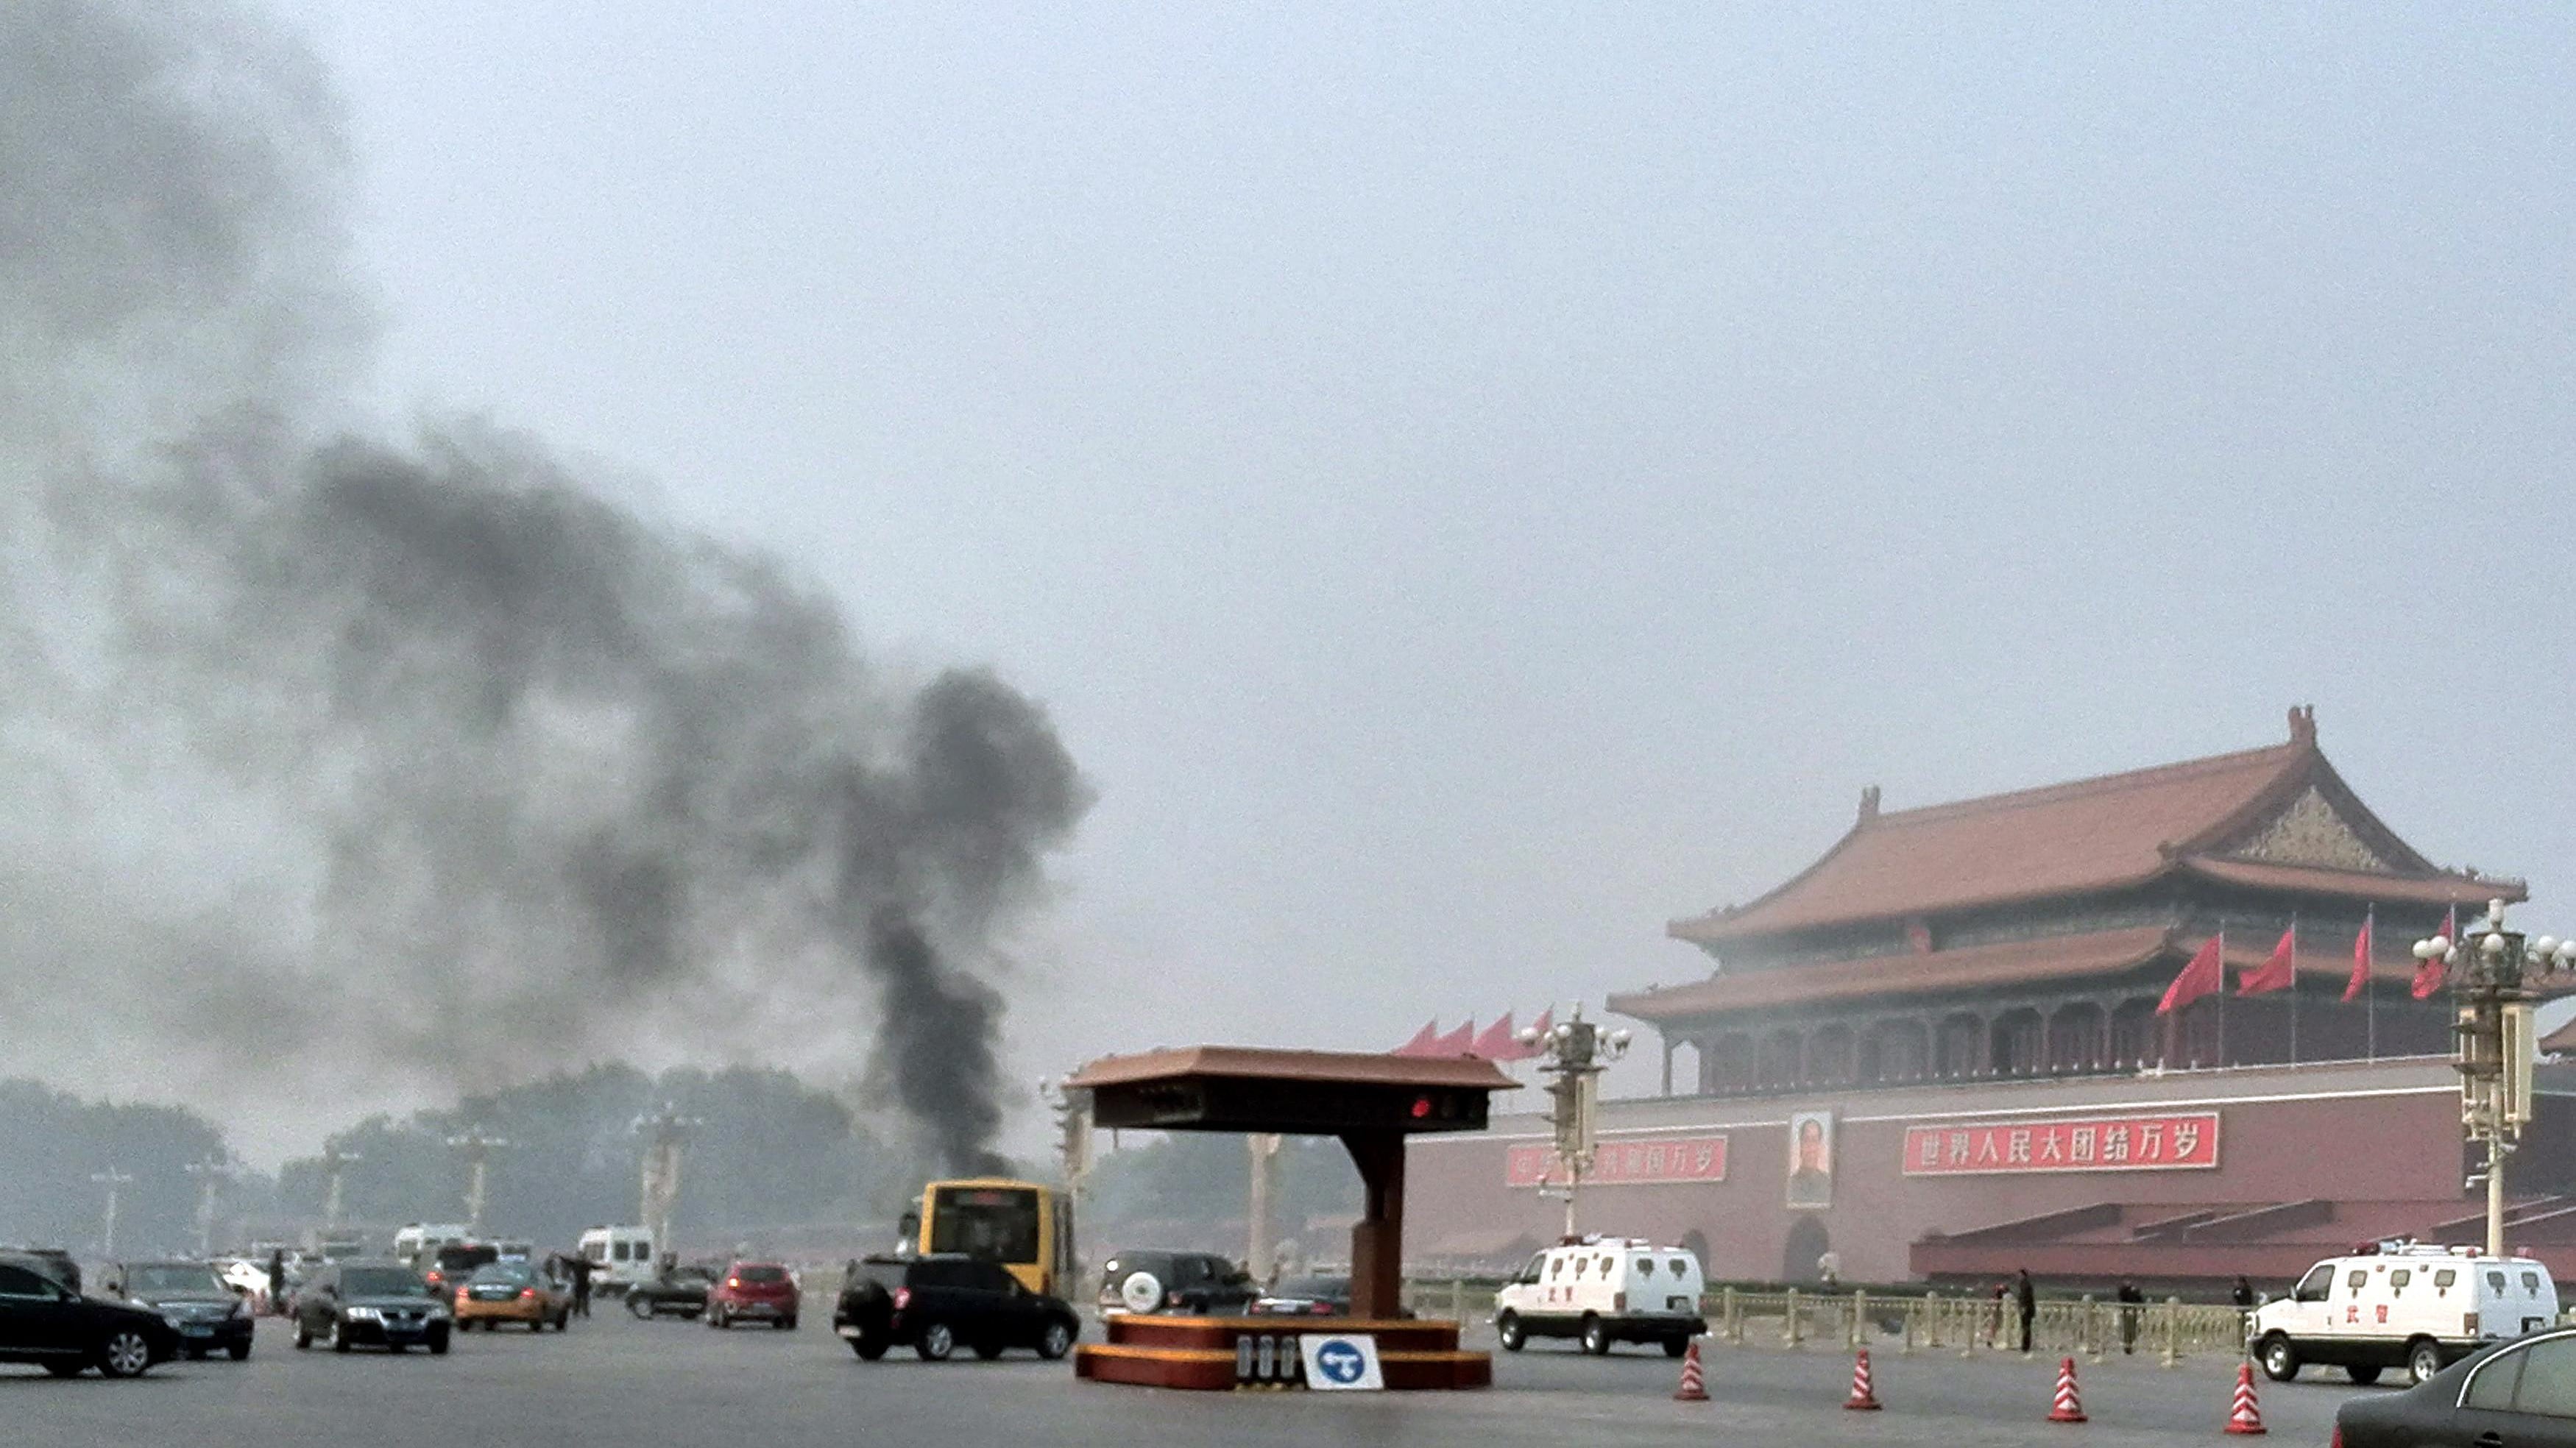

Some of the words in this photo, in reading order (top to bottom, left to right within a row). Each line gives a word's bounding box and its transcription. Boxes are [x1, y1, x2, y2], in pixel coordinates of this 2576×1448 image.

[1921, 1122, 2199, 1166] 世界人民大团结万岁
